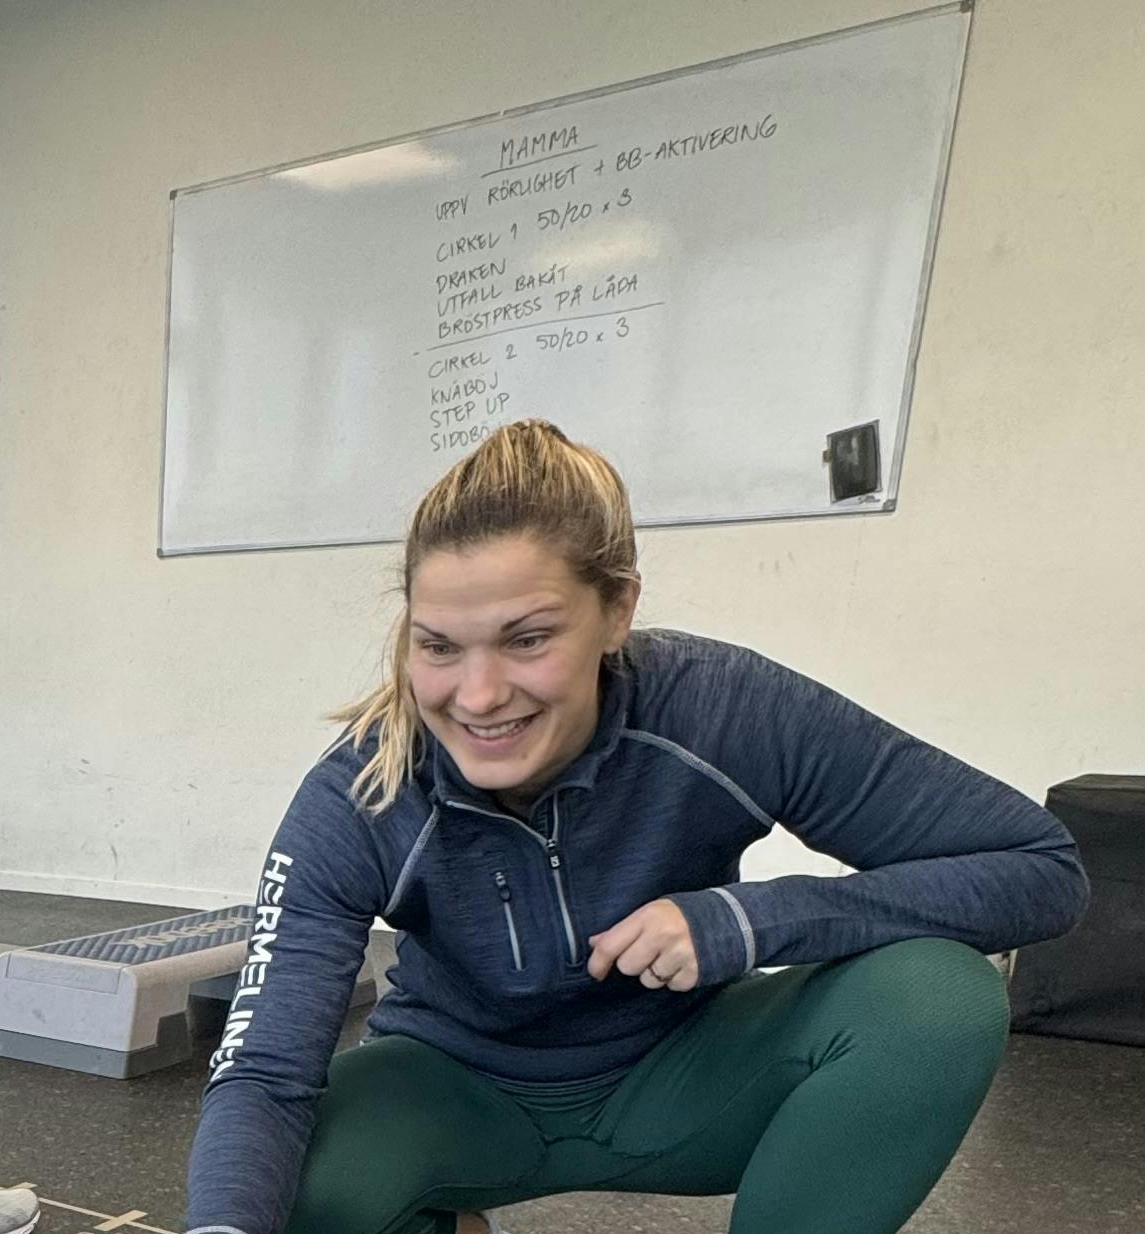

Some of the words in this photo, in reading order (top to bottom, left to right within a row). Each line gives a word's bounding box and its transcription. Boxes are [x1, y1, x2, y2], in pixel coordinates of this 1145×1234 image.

[487, 165, 581, 205] RÖRLIGHET
[594, 159, 605, 175] +
[616, 114, 778, 171] BB-AKTIVERING
[500, 126, 579, 168] MAMMA
[436, 232, 502, 262] CIRKEL
[510, 222, 518, 240] 1
[537, 201, 592, 230] 50/20
[616, 188, 633, 207] 3
[436, 258, 506, 294] DRAKEN
[437, 284, 502, 317] UTFALL
[514, 263, 570, 292] BAKÅT
[555, 285, 582, 311] PÅ
[428, 352, 492, 378] CIRKEL
[505, 344, 518, 360] 2
[536, 327, 589, 352] 50/20
[615, 316, 630, 338] 3
[430, 400, 476, 428] STEP
[486, 392, 510, 415] UP
